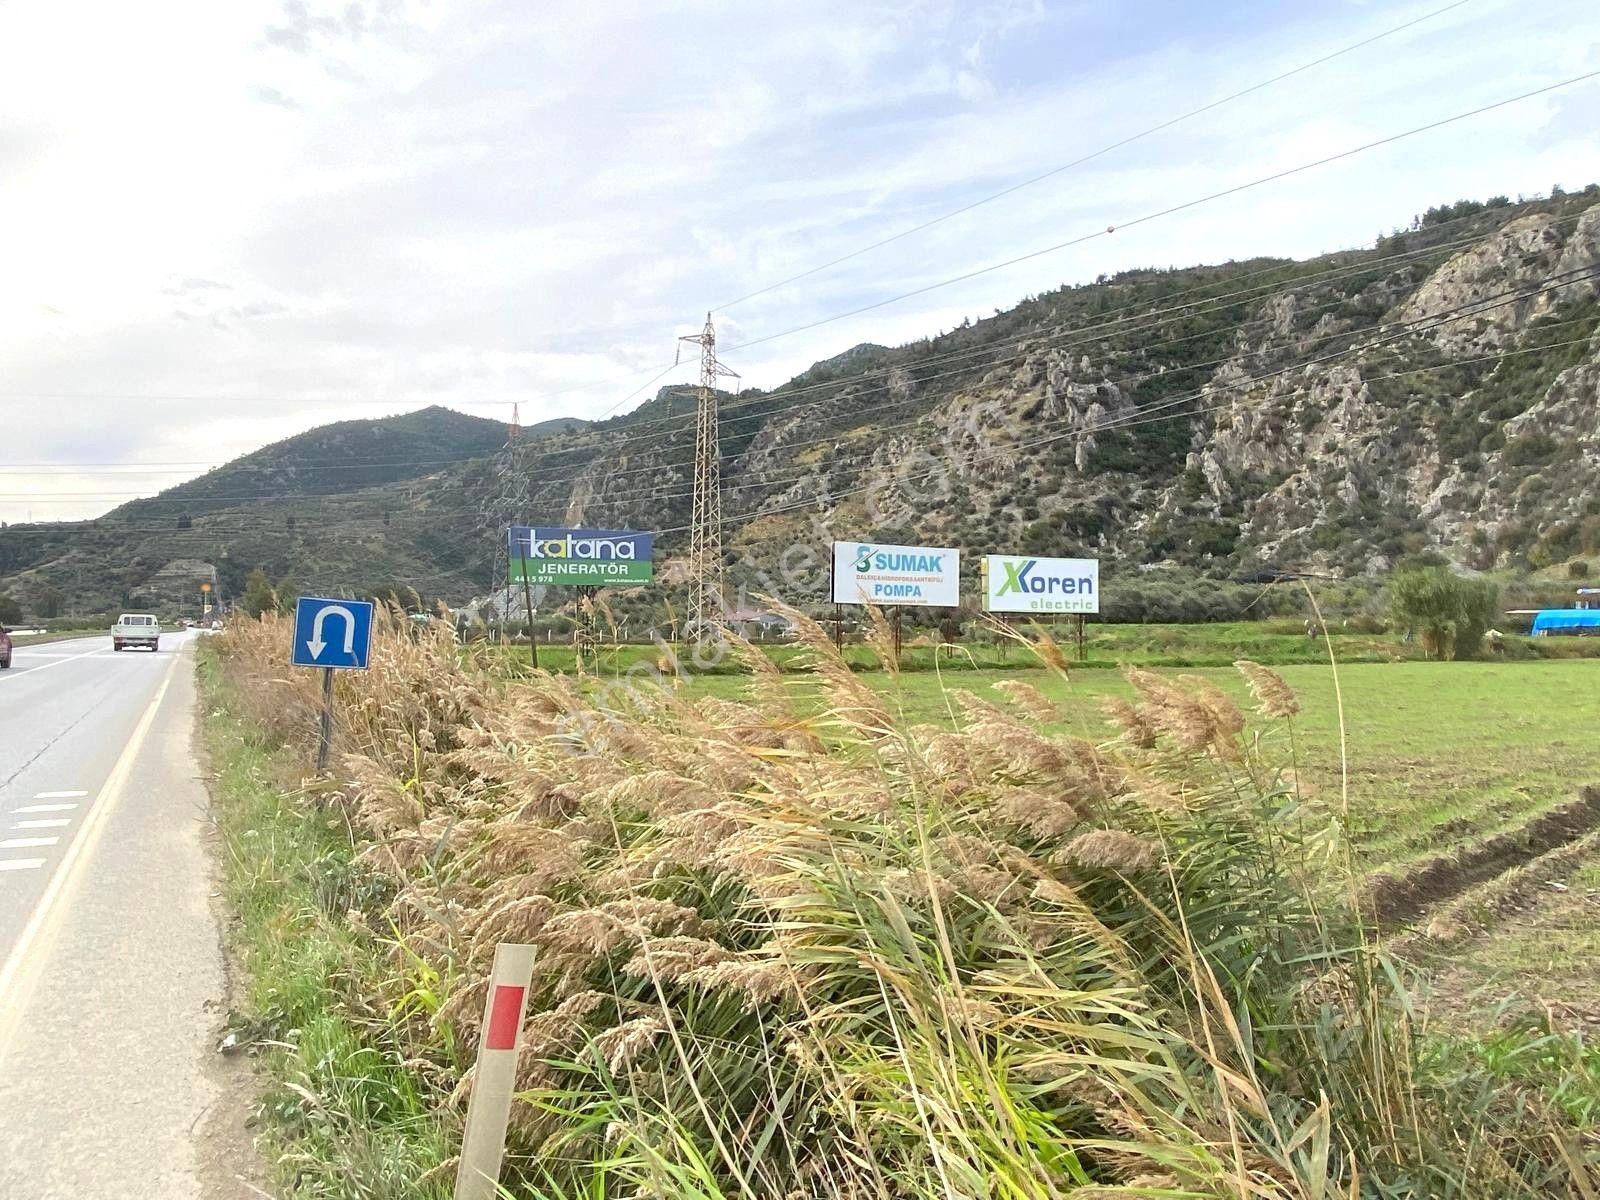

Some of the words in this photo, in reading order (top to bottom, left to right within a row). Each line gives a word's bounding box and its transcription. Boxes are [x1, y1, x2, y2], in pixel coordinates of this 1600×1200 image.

[530, 529, 635, 559] katana
[539, 562, 628, 575] JENERATÖR
[876, 554, 943, 572] SUMAK
[875, 584, 922, 597] POMPA
[1031, 598, 1093, 610] electric
